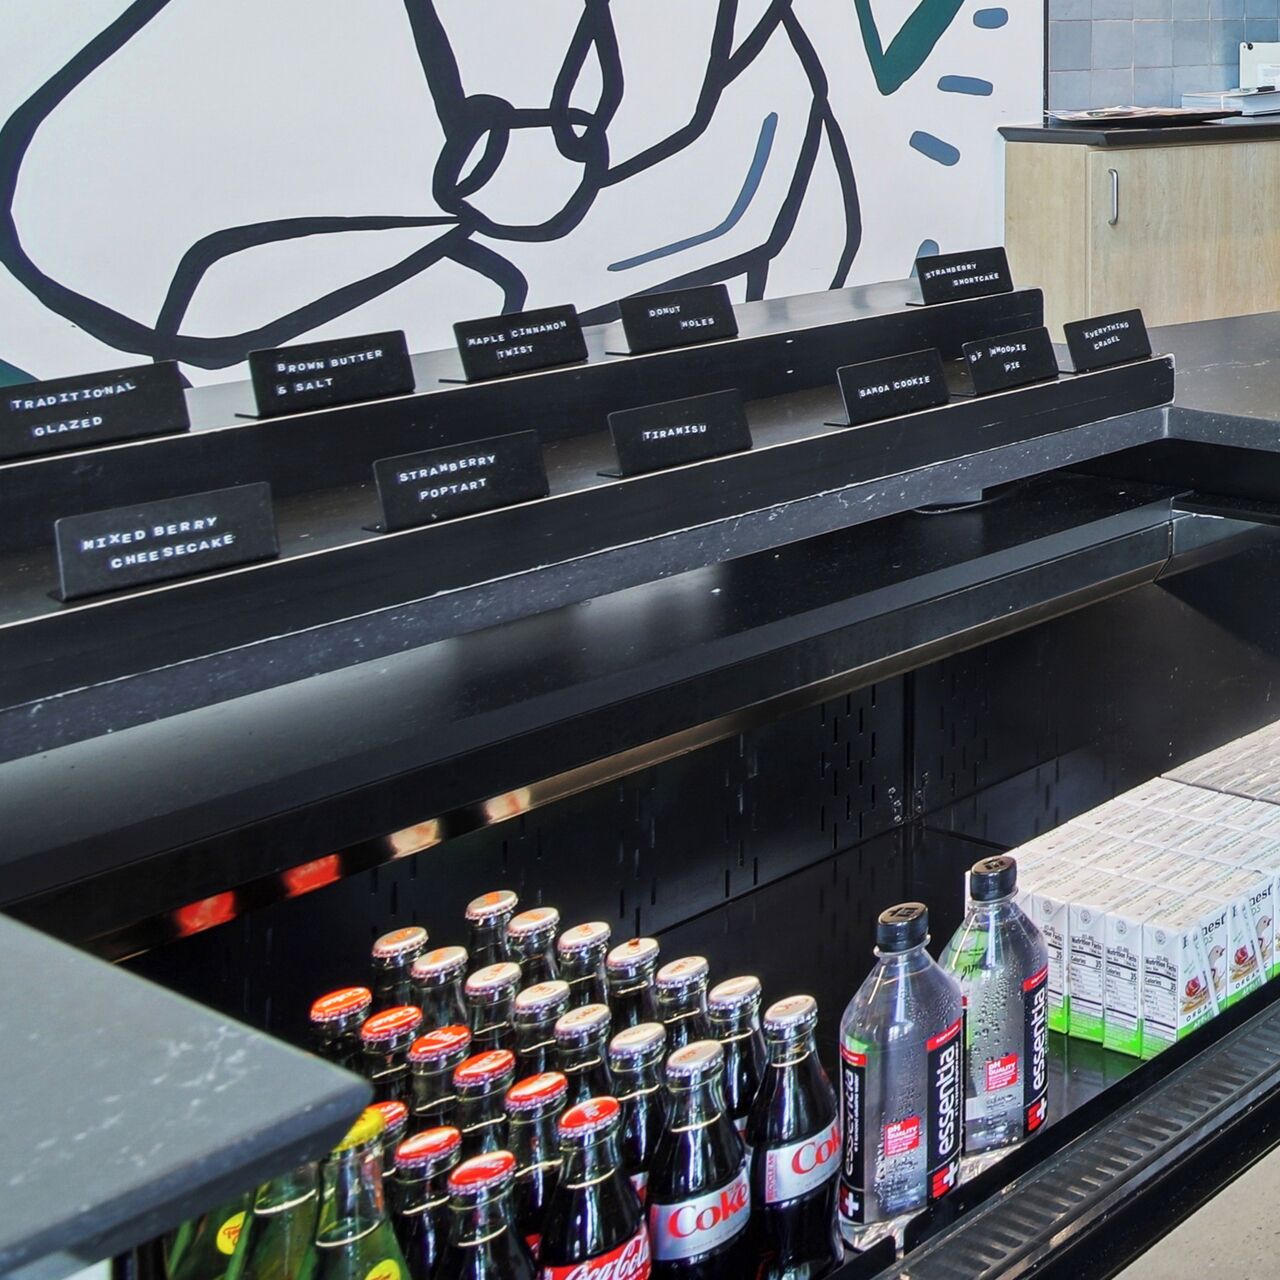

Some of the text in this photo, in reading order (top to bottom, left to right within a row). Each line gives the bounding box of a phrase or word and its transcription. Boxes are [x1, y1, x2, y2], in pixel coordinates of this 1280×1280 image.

[925, 262, 978, 280] STRAWBERRY
[952, 272, 1000, 287] SHORTCAKE
[649, 305, 681, 317] DONUT
[467, 320, 568, 346] MAPLE CINNAMON
[681, 317, 715, 329] HOLES
[1085, 321, 1130, 340] EVERYTHING
[277, 349, 383, 373] BROWN BUTTER
[497, 345, 534, 359] TWIST
[970, 350, 983, 364] GF
[1004, 360, 1021, 372] PIE
[12, 381, 137, 410] TRADITIONAL
[296, 377, 334, 392] SALT
[859, 375, 931, 399] SAMOA COOKIE
[34, 416, 103, 437] GLAZED
[643, 424, 707, 440] TIRAMISU
[398, 455, 496, 483] STRAWBERRY
[419, 478, 487, 501] POPTART
[83, 517, 218, 551] MIXED BERRY
[111, 534, 236, 569] CHEESECAKE
[1031, 987, 1046, 1090] essentia
[936, 1043, 956, 1156] essentia
[668, 1182, 748, 1238] Coke
